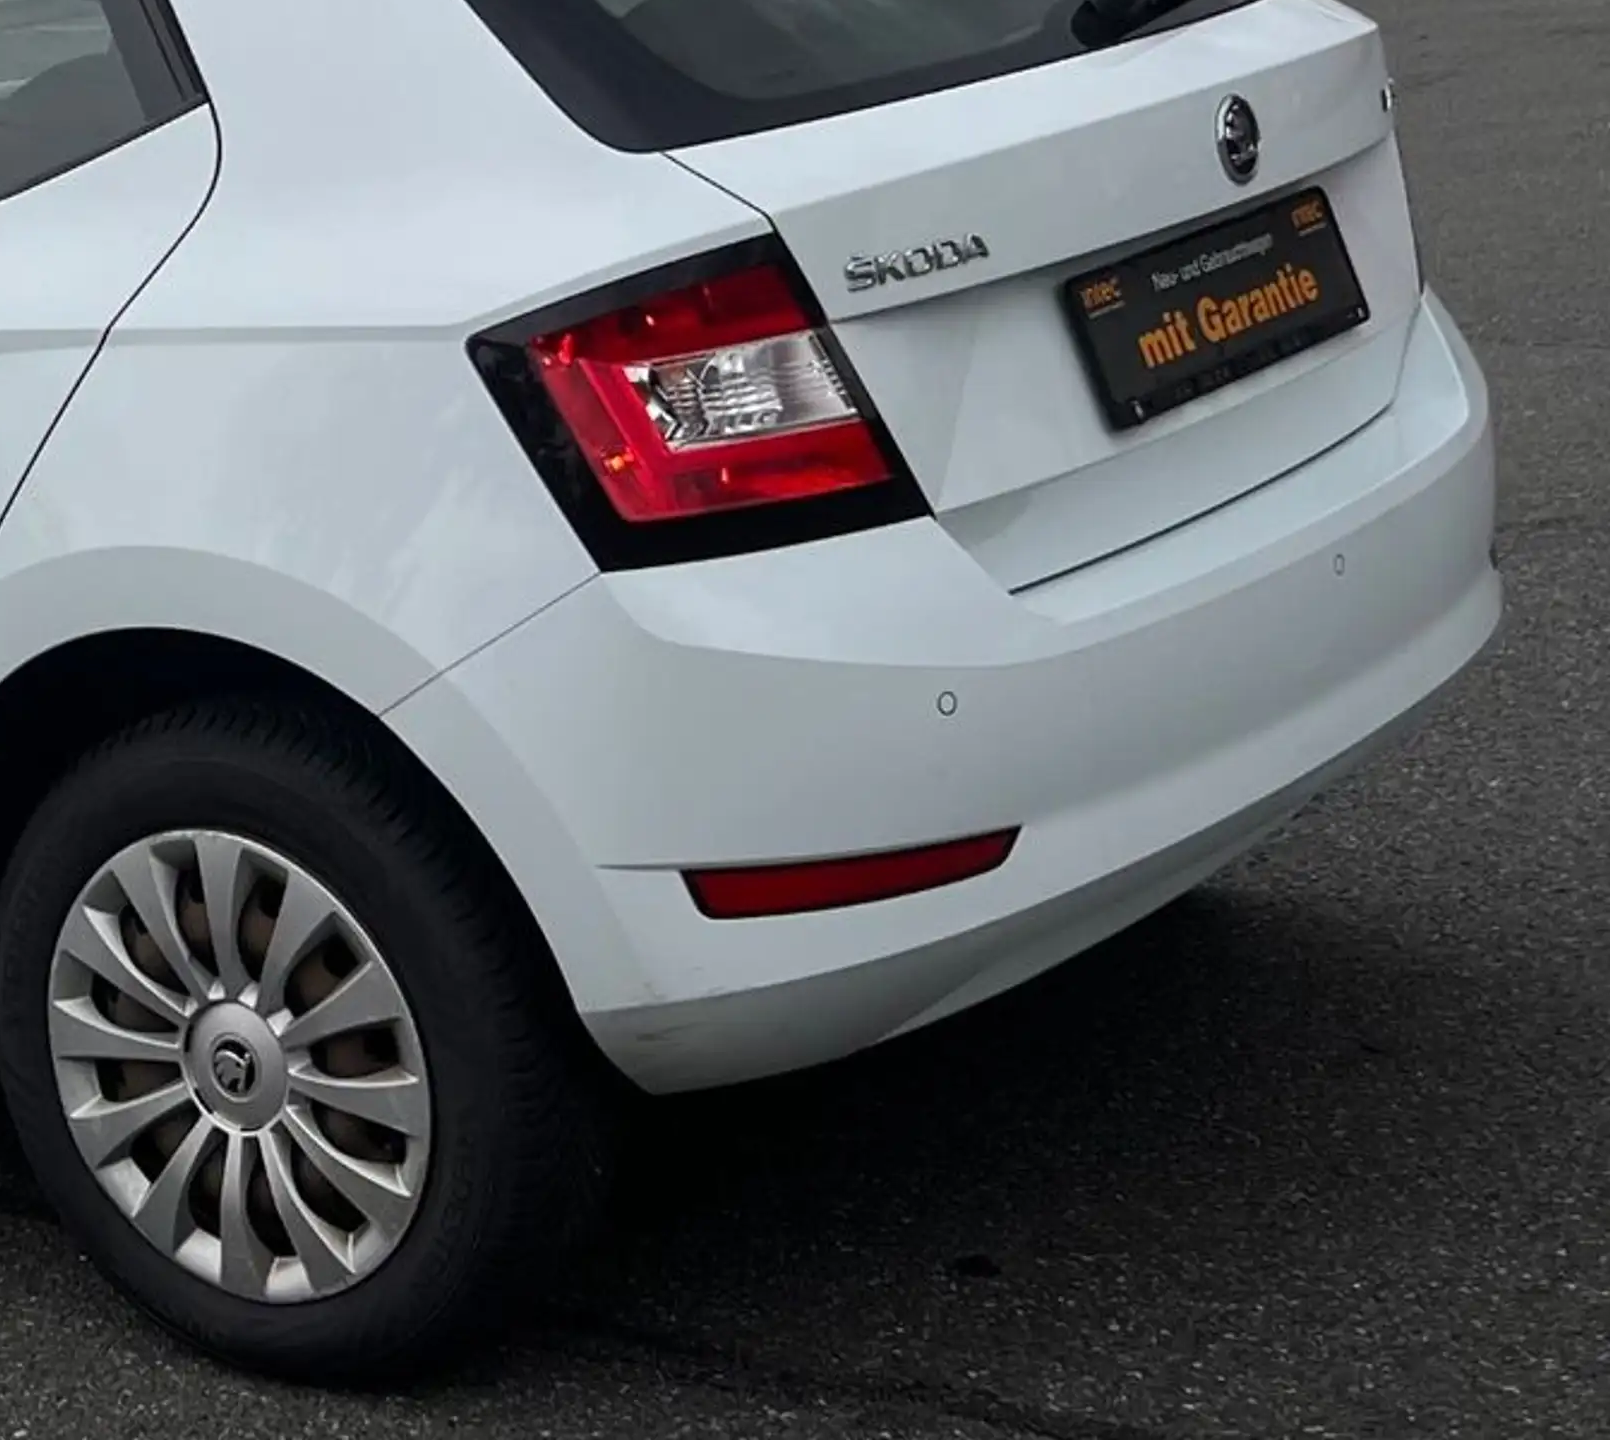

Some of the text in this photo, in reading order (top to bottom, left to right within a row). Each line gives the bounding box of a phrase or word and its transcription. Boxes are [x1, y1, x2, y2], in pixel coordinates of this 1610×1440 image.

[845, 233, 989, 293] ŠKODA
[1138, 311, 1196, 368] mit
[1196, 262, 1319, 343] Garantie
